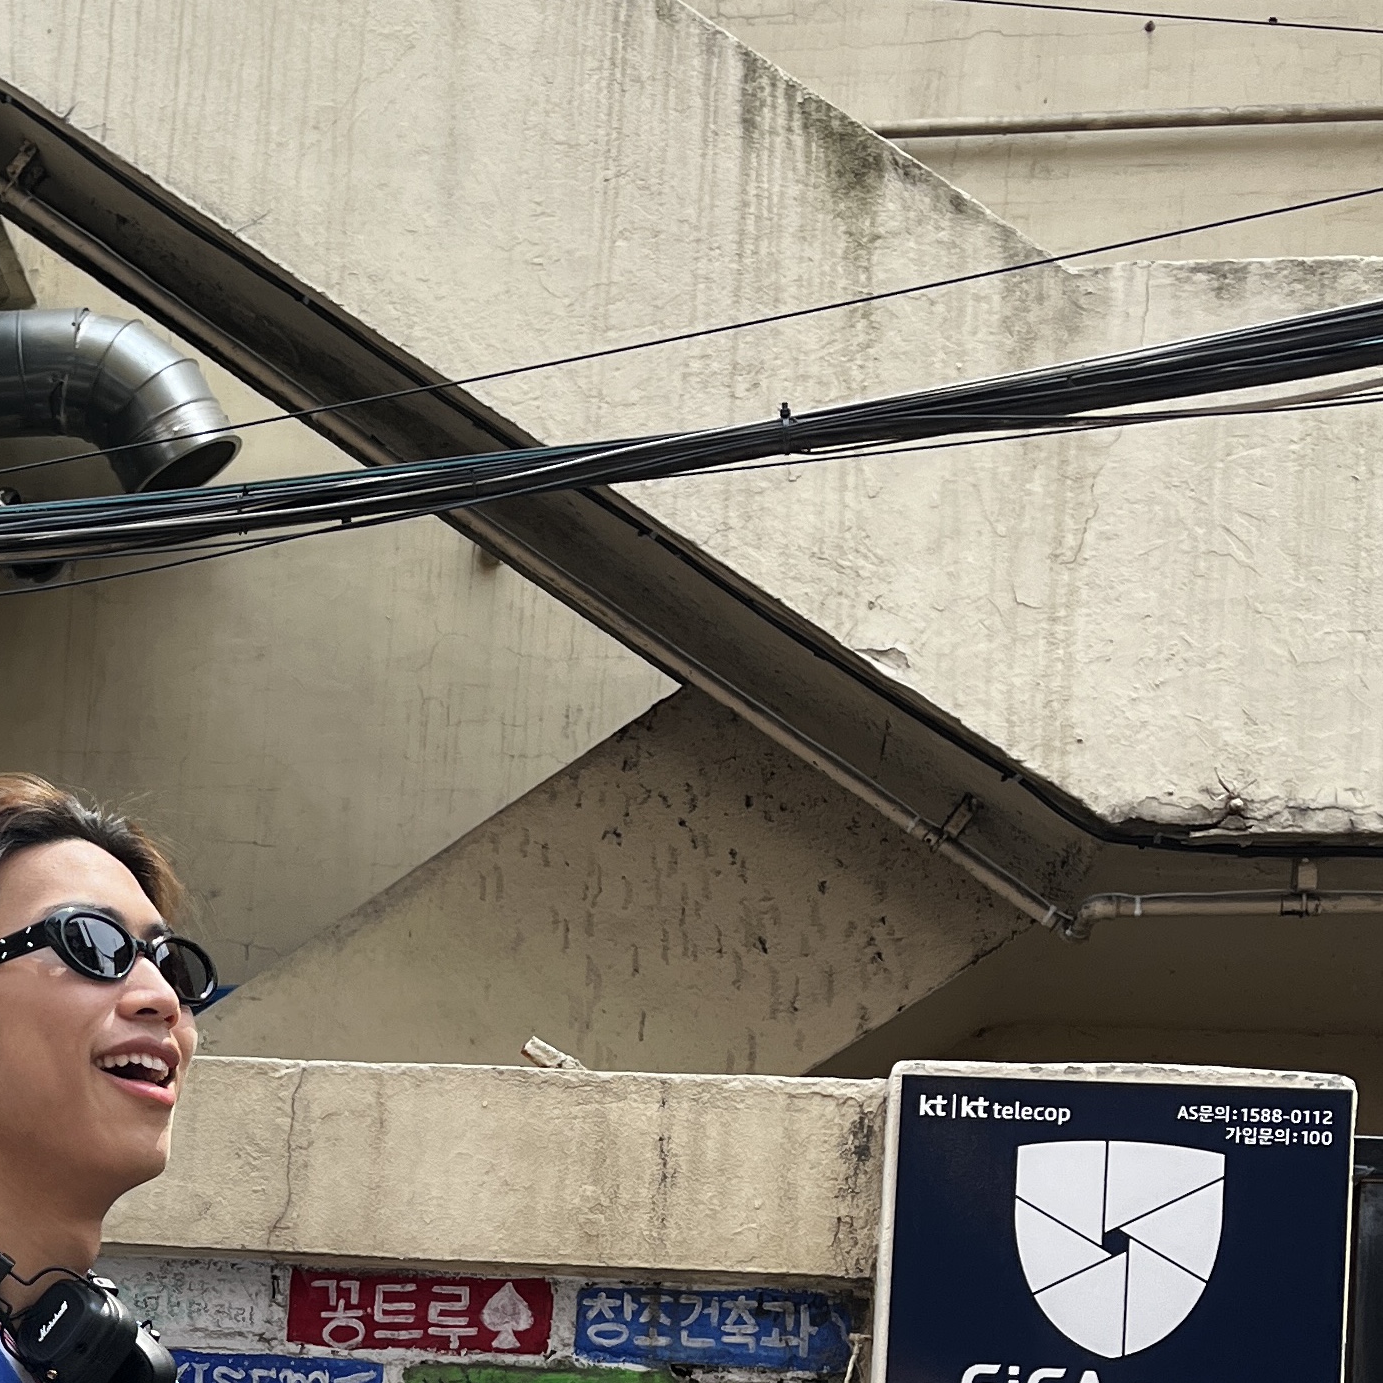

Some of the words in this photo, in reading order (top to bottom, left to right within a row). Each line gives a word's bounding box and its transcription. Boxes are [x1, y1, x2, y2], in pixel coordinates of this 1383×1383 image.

[919, 1095, 947, 1117] kt
[960, 1096, 989, 1119] kt
[993, 1101, 1071, 1125] telecop
